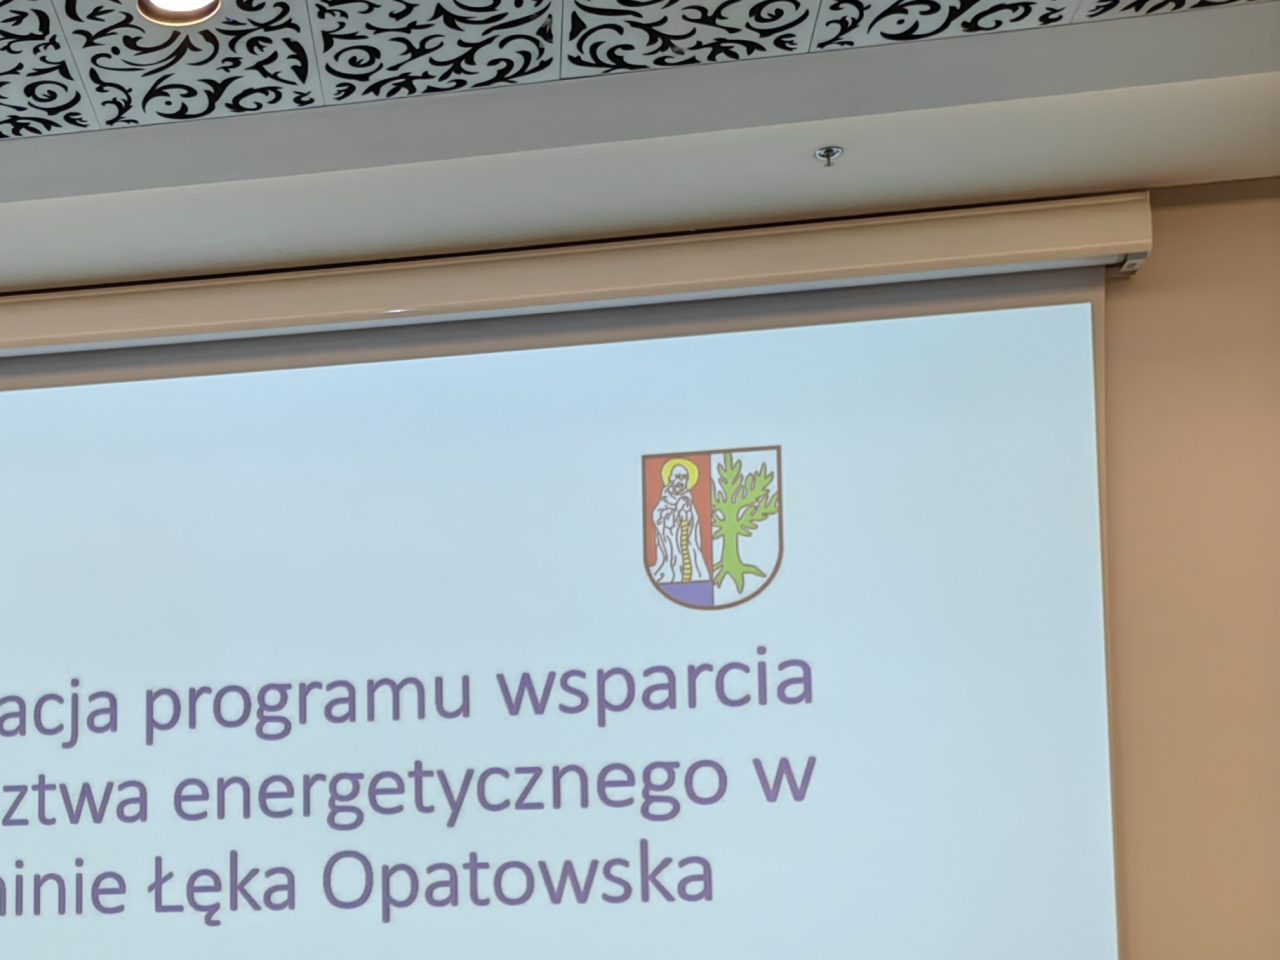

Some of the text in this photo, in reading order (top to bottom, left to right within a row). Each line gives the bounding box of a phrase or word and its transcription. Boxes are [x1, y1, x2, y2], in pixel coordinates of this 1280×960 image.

[145, 674, 471, 747] programu
[495, 644, 813, 729] wsparcia
[173, 758, 728, 832] energetycznego
[751, 755, 817, 804] w
[146, 849, 296, 928] Łęka
[322, 837, 714, 924] Opatowska
